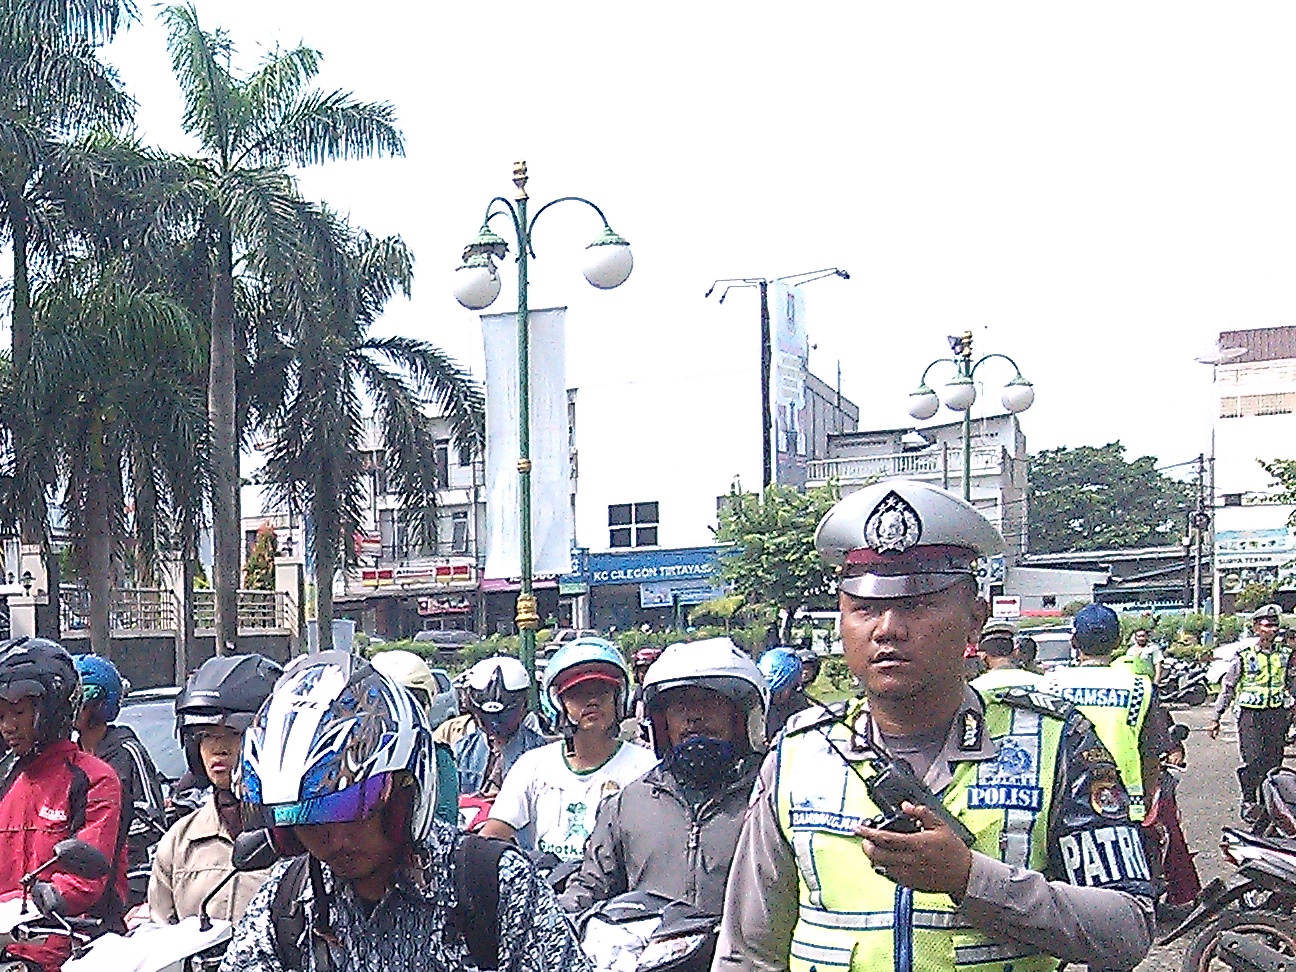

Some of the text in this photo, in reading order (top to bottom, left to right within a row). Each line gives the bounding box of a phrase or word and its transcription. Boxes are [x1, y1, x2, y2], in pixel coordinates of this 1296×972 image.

[593, 571, 609, 582] KC
[610, 567, 657, 581] CILEGON
[1062, 688, 1128, 706] SAMSAT
[970, 786, 1040, 808] POLISI
